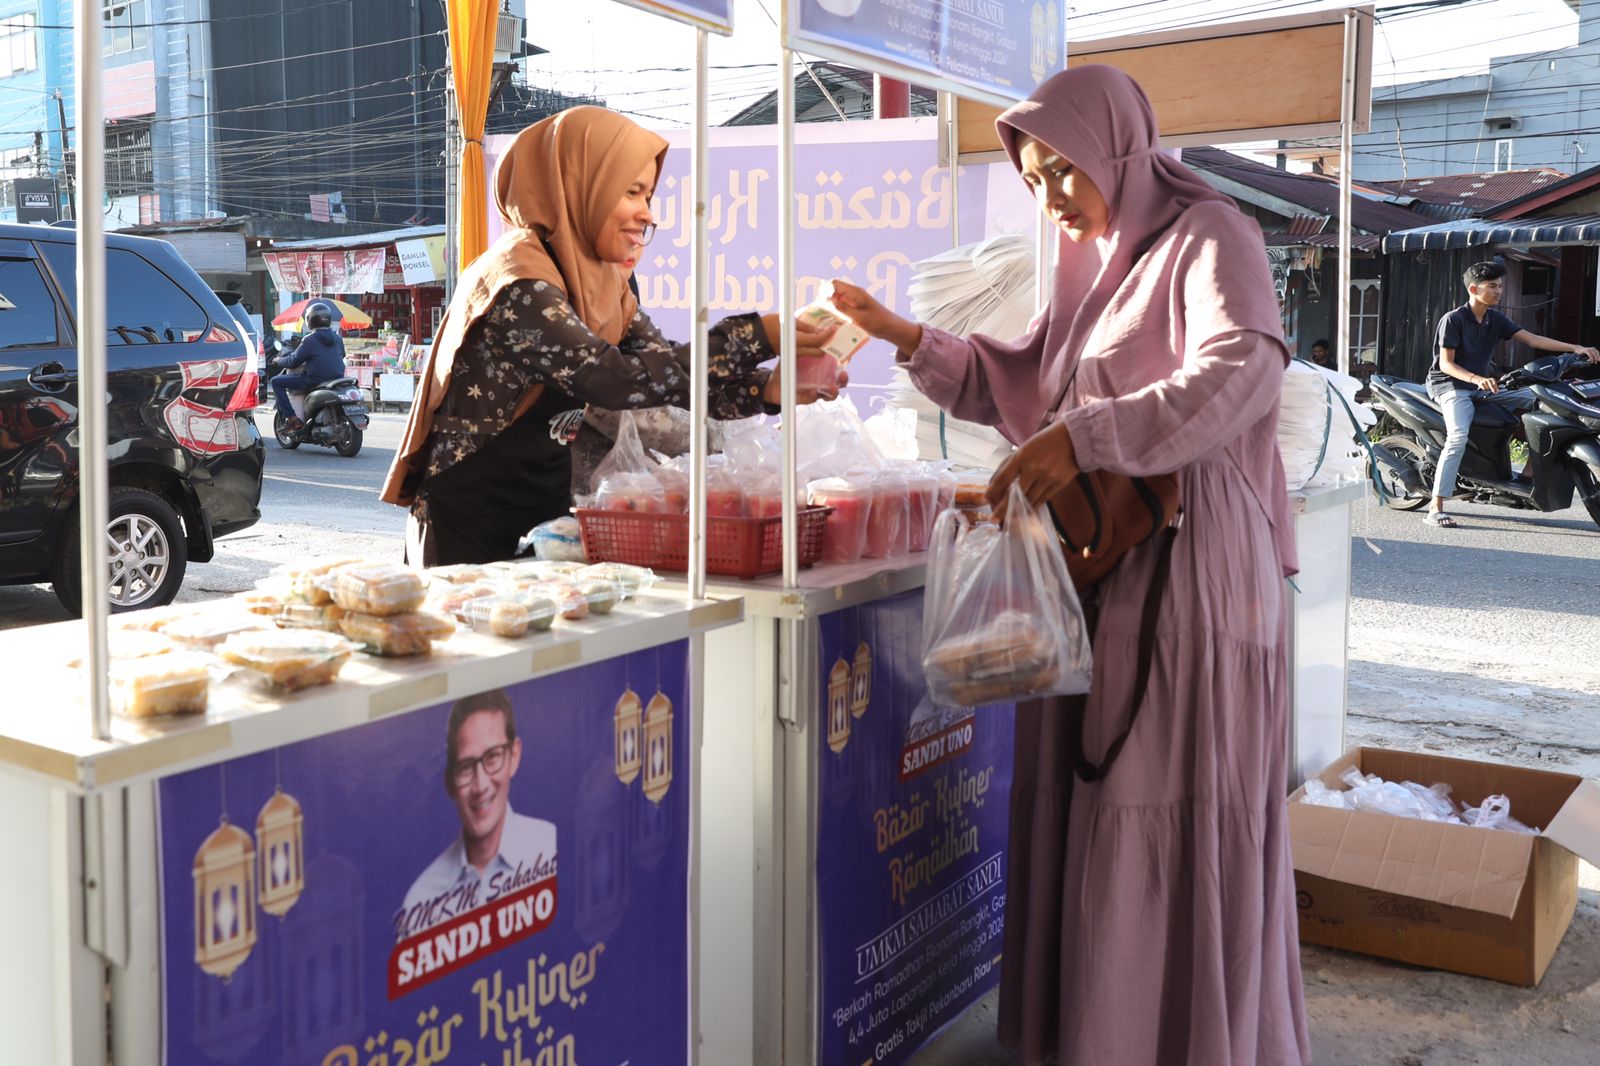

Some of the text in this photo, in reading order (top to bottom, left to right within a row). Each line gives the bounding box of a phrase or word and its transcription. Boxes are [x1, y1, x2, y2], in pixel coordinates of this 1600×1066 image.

[401, 251, 427, 261] DAHLIA
[403, 261, 431, 271] PONSEL
[903, 724, 973, 775] SANDI UNO
[486, 852, 557, 902] Sahabat
[857, 861, 1001, 977] UMKM SAHABAT SANDI
[397, 888, 554, 986] SANDI UNO
[866, 1007, 889, 1033] Juta
[891, 971, 937, 1017] Lapangan
[937, 953, 959, 983] Kerja
[959, 931, 987, 962] Hingga
[873, 951, 925, 1001] Ramadhan
[926, 928, 959, 964] Ekonomi
[960, 904, 991, 938] Bangkit,
[875, 1028, 905, 1061] Gratis
[929, 974, 973, 1019] Pekanbaru
[973, 960, 991, 984] Riau
